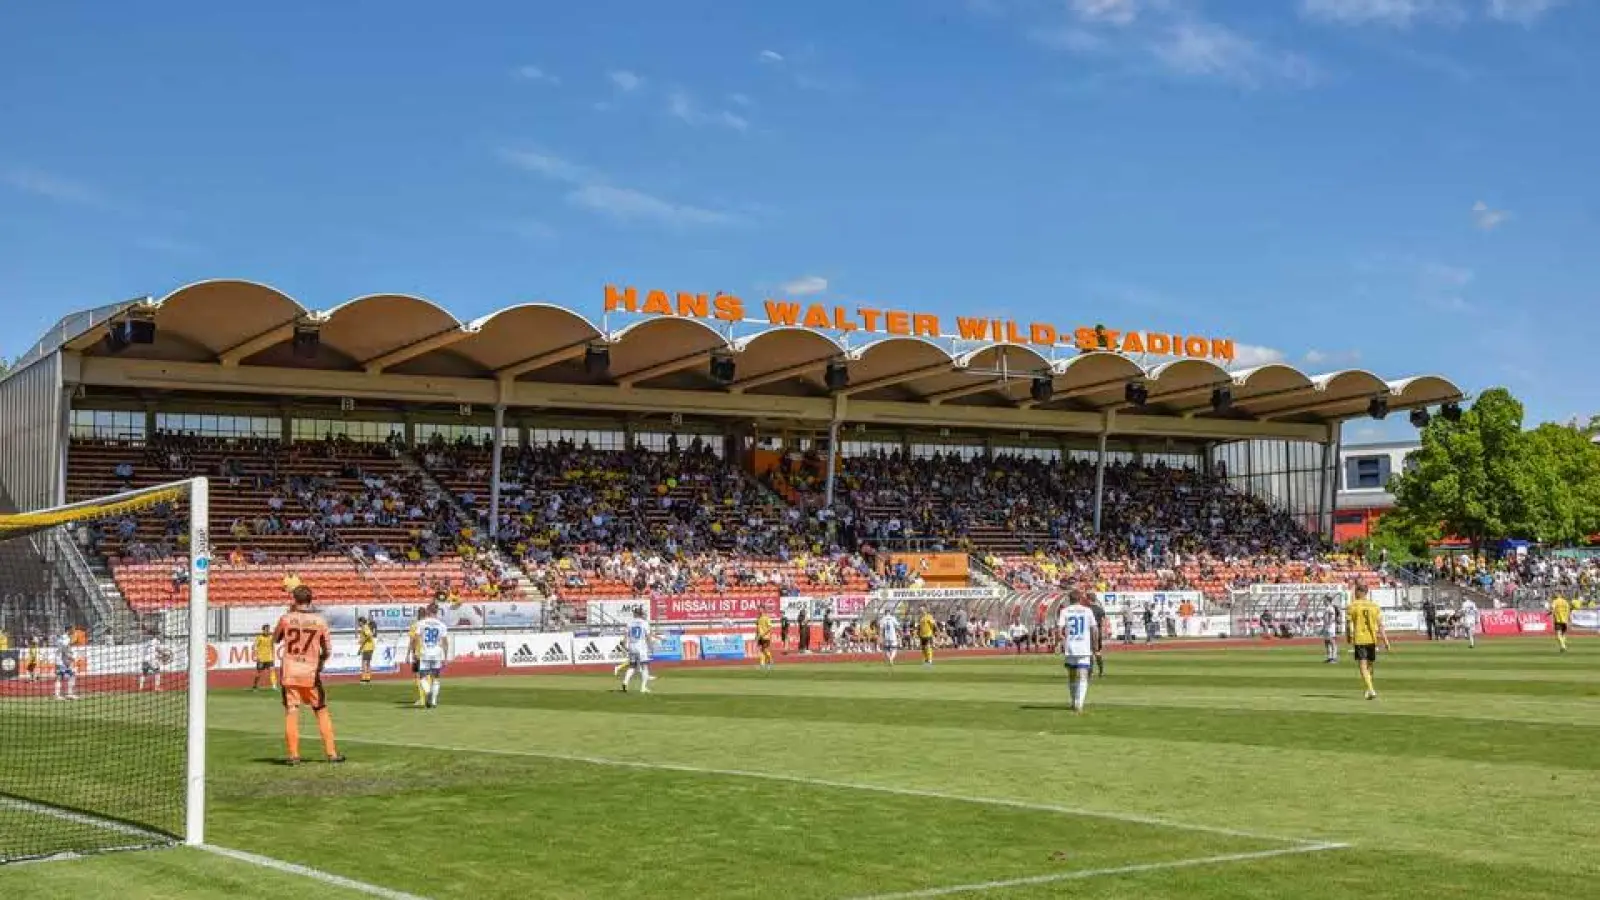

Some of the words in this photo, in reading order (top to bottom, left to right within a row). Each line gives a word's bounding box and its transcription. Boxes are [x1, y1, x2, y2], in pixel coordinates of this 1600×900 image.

[604, 283, 744, 321] HANS
[764, 299, 940, 337] WALTER
[956, 316, 1235, 360] WILD-STADION
[672, 599, 716, 612] NISSAN
[719, 599, 737, 611] IST
[1067, 616, 1085, 636] 31
[287, 627, 318, 655] 27
[510, 655, 538, 663] adidas
[541, 654, 568, 662] adidas
